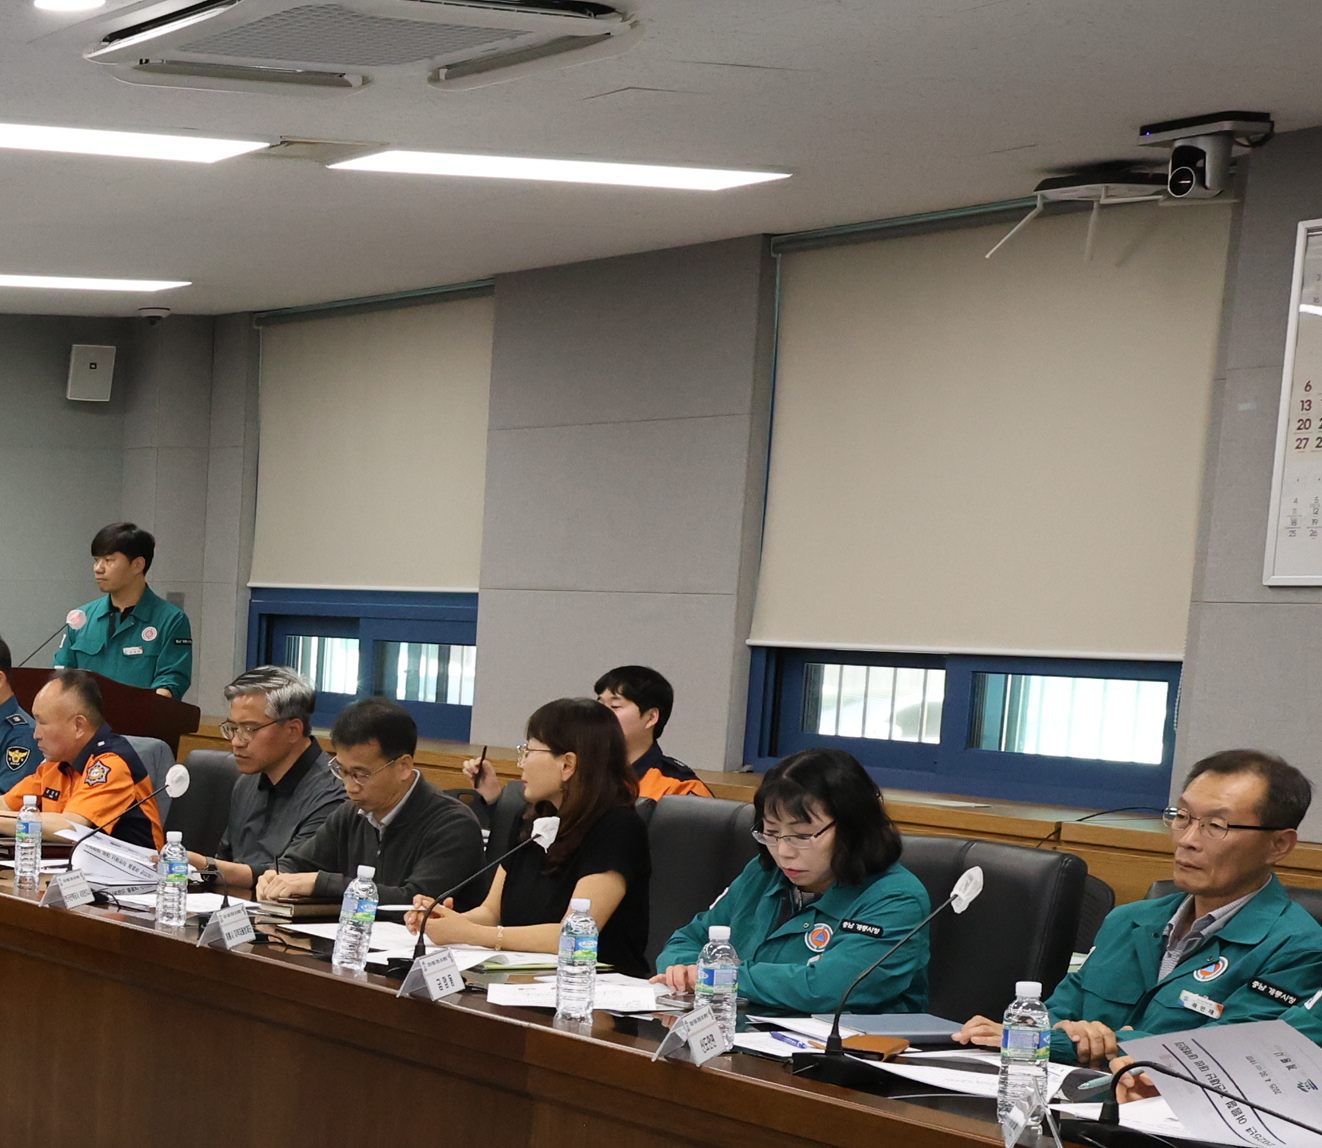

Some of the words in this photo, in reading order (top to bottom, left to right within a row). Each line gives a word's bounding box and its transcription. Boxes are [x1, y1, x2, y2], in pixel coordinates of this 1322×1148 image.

[1304, 380, 1312, 392] 6
[1300, 399, 1312, 411] 13
[1297, 418, 1312, 431] 20
[1295, 437, 1310, 450] 27
